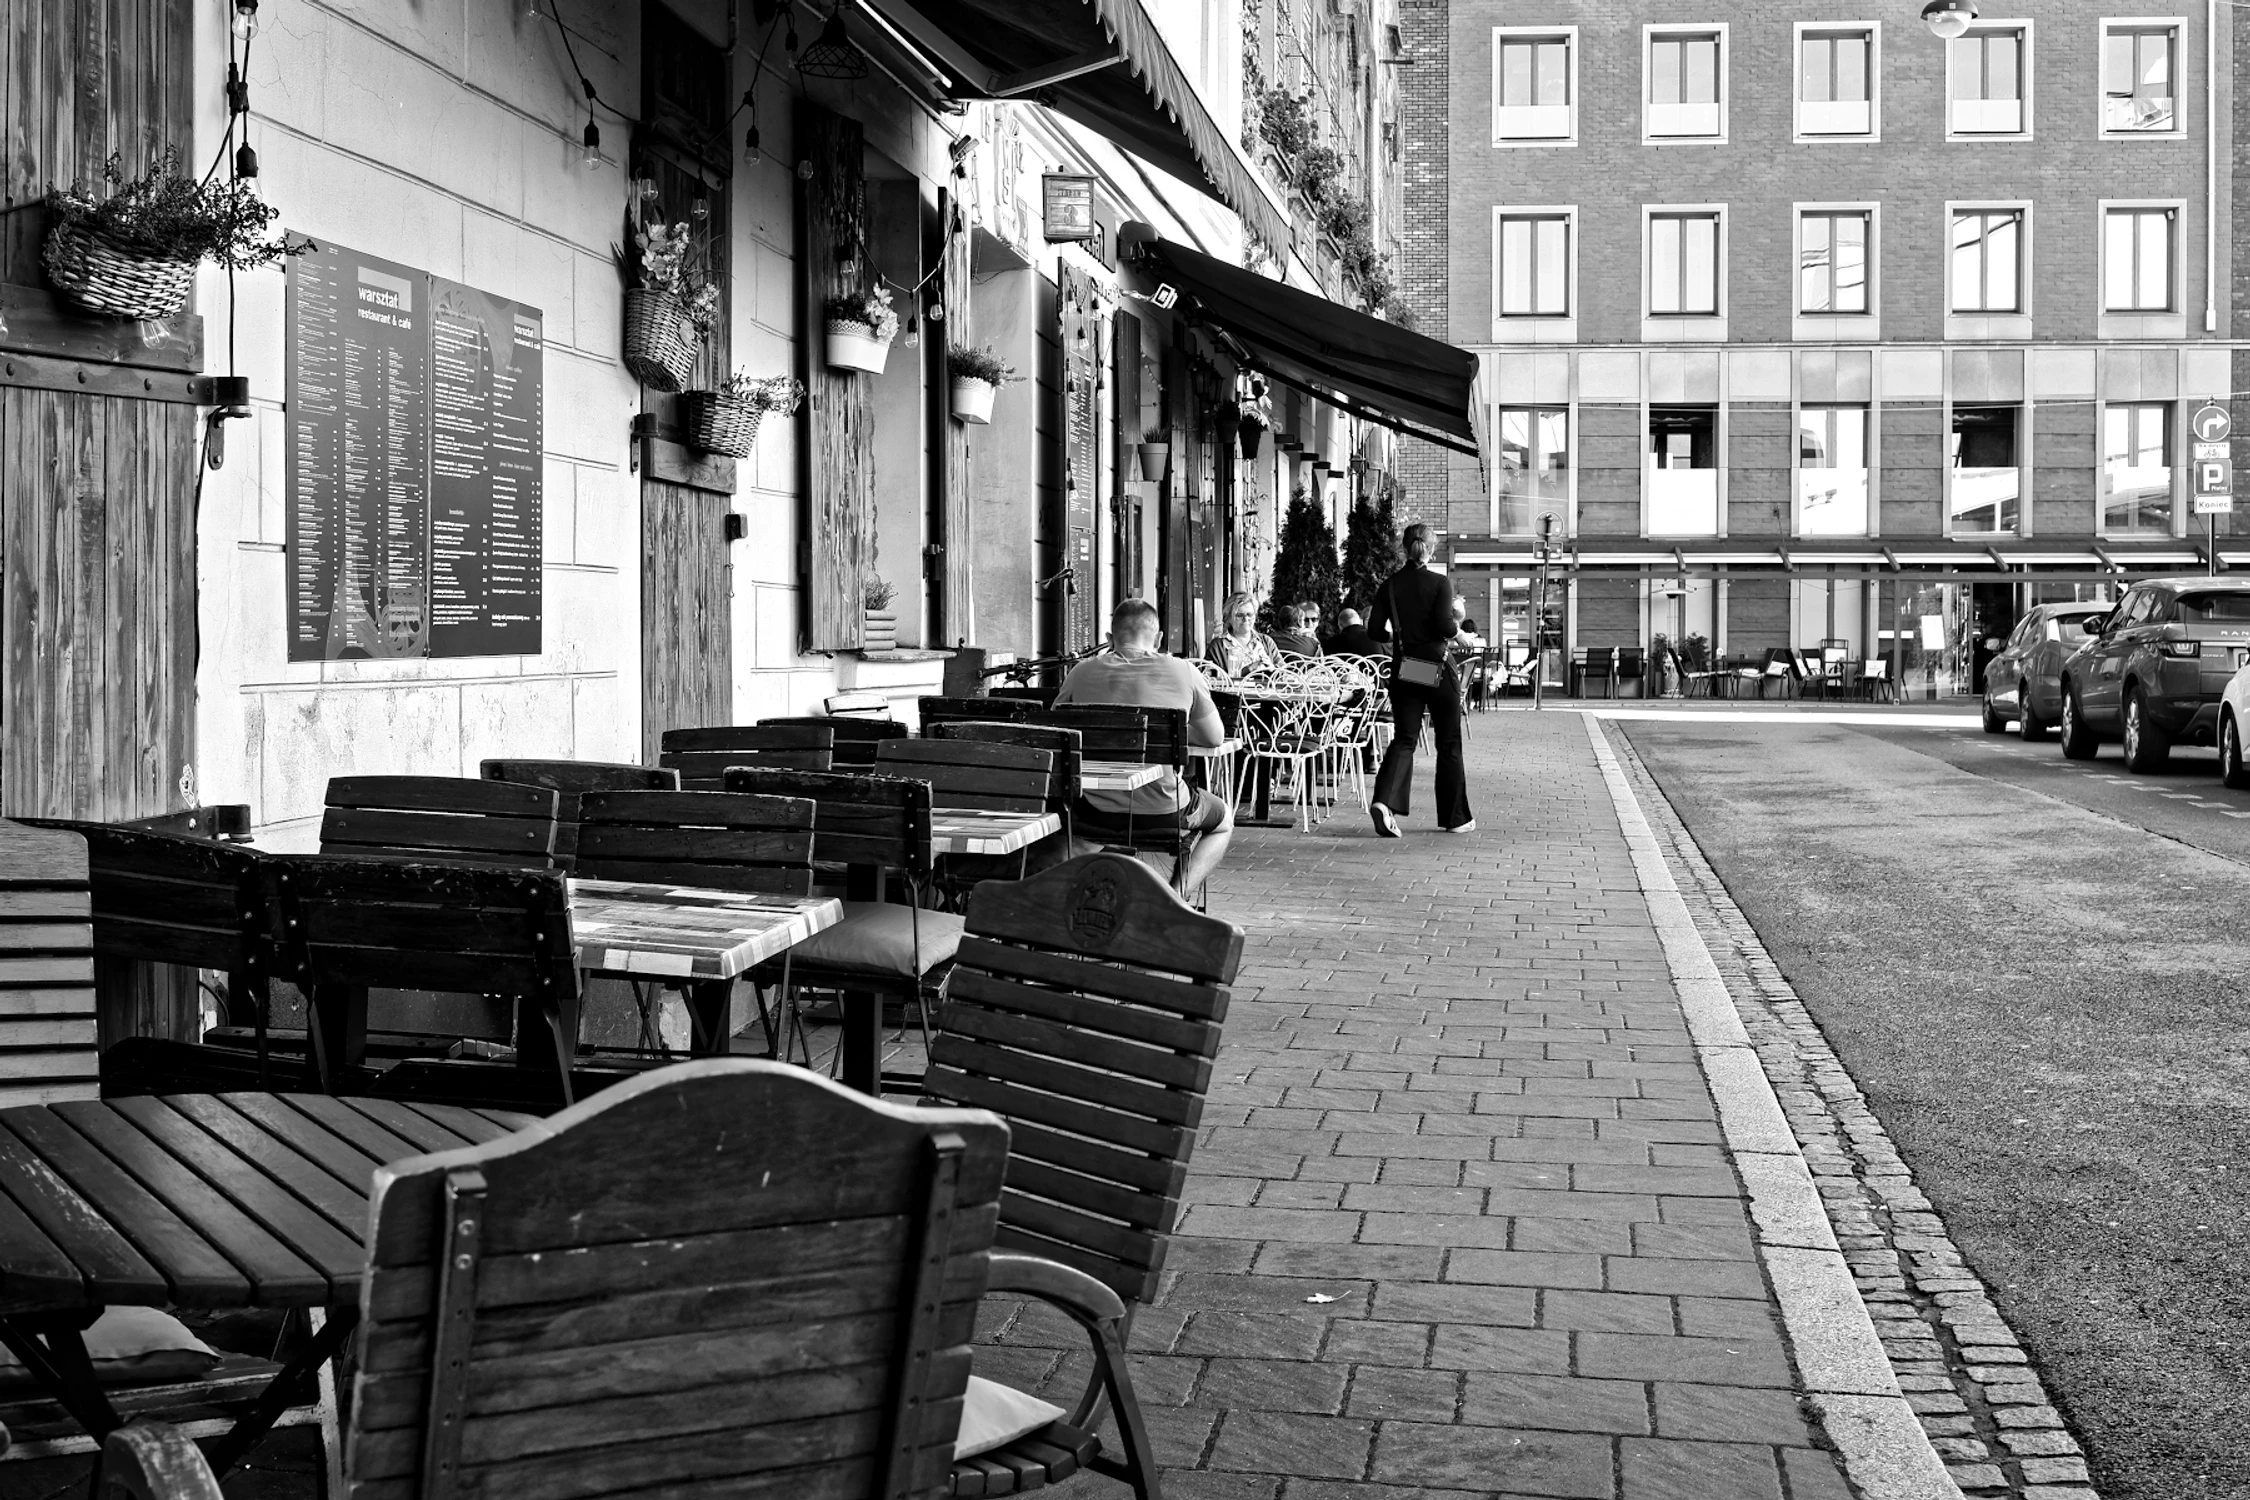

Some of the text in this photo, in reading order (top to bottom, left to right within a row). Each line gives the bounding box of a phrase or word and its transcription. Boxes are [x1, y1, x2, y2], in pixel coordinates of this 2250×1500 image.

[358, 287, 398, 309] warsztat
[358, 308, 391, 325] restaurant
[392, 315, 397, 326] &
[2203, 463, 2224, 492] P
[2199, 500, 2229, 508] Koniec
